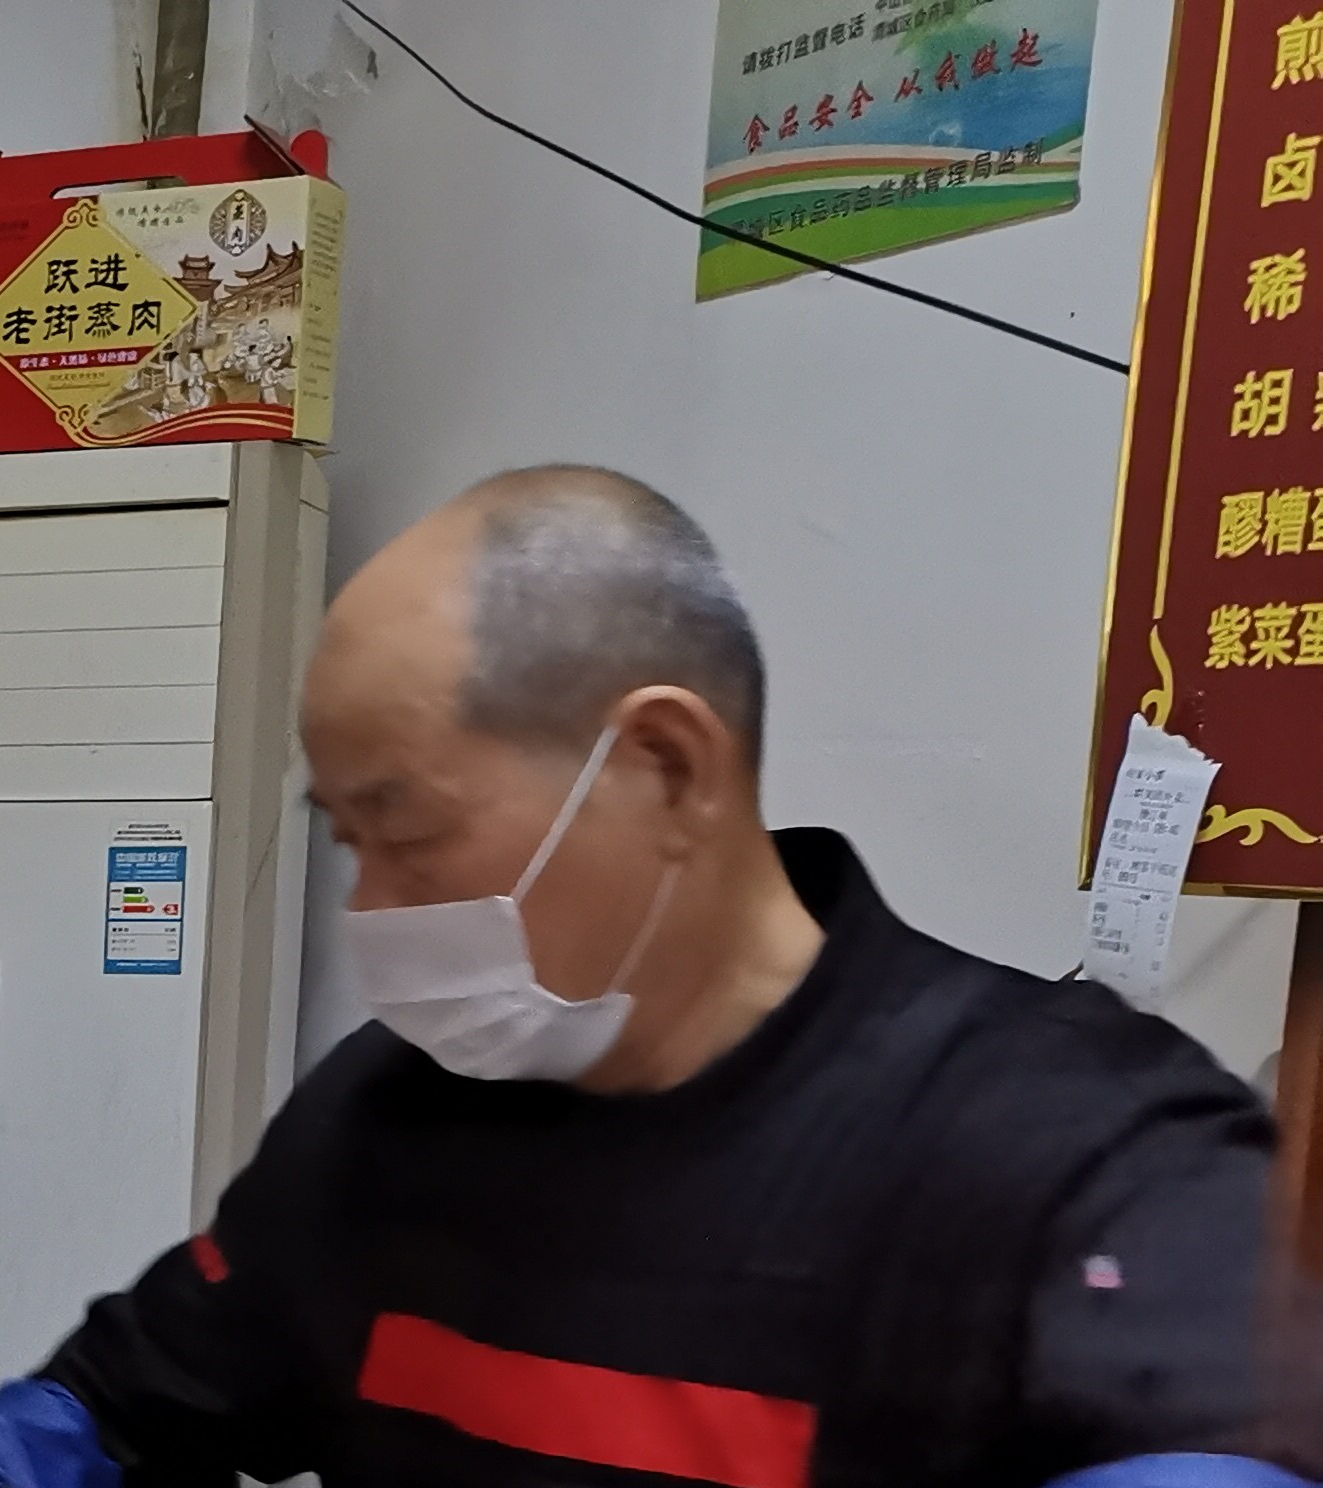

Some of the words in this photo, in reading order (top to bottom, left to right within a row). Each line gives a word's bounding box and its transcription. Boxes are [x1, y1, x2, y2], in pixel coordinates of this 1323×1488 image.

[743, 80, 875, 155] 食品安全
[895, 26, 1044, 102] 从我做起
[1261, 132, 1323, 208] 卤
[43, 253, 130, 294] 跃进
[1243, 248, 1308, 324] 稀
[2, 299, 163, 345] 老街蒸肉
[1230, 368, 1323, 438] 胡
